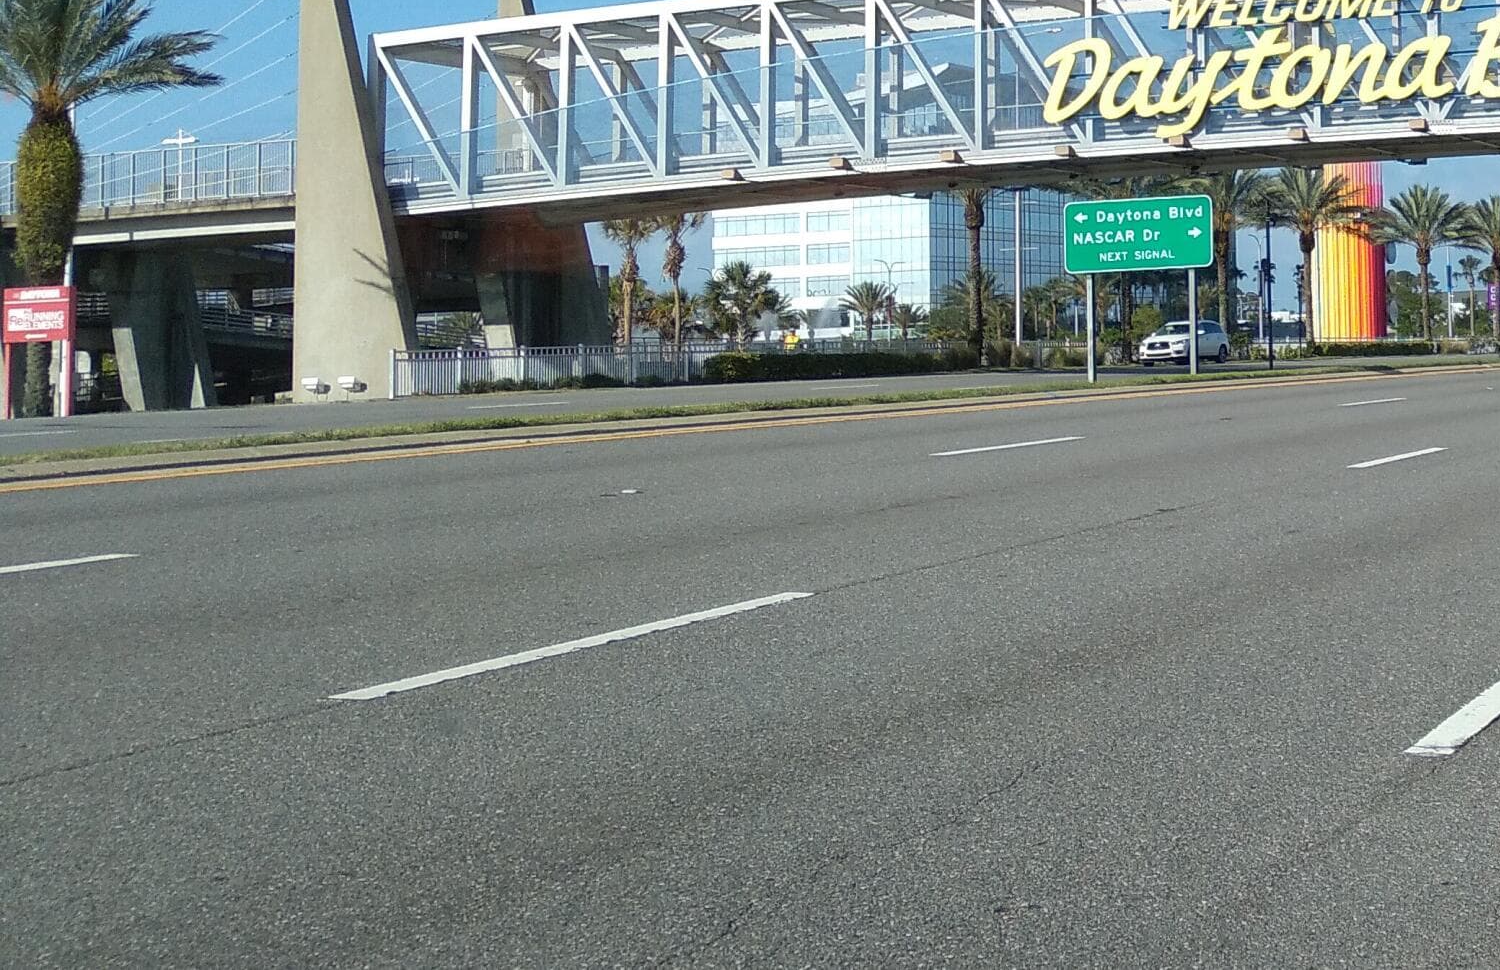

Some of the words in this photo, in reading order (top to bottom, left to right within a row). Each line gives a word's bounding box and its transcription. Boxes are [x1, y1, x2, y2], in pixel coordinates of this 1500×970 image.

[1043, 25, 1456, 138] Daytona
[1096, 209, 1161, 224] Daytona
[1168, 206, 1203, 219] Blvd
[1073, 229, 1135, 245] NASCAR
[1143, 229, 1160, 242] Dr
[1099, 251, 1128, 262] NEXT
[1134, 249, 1175, 260] SIGNAL
